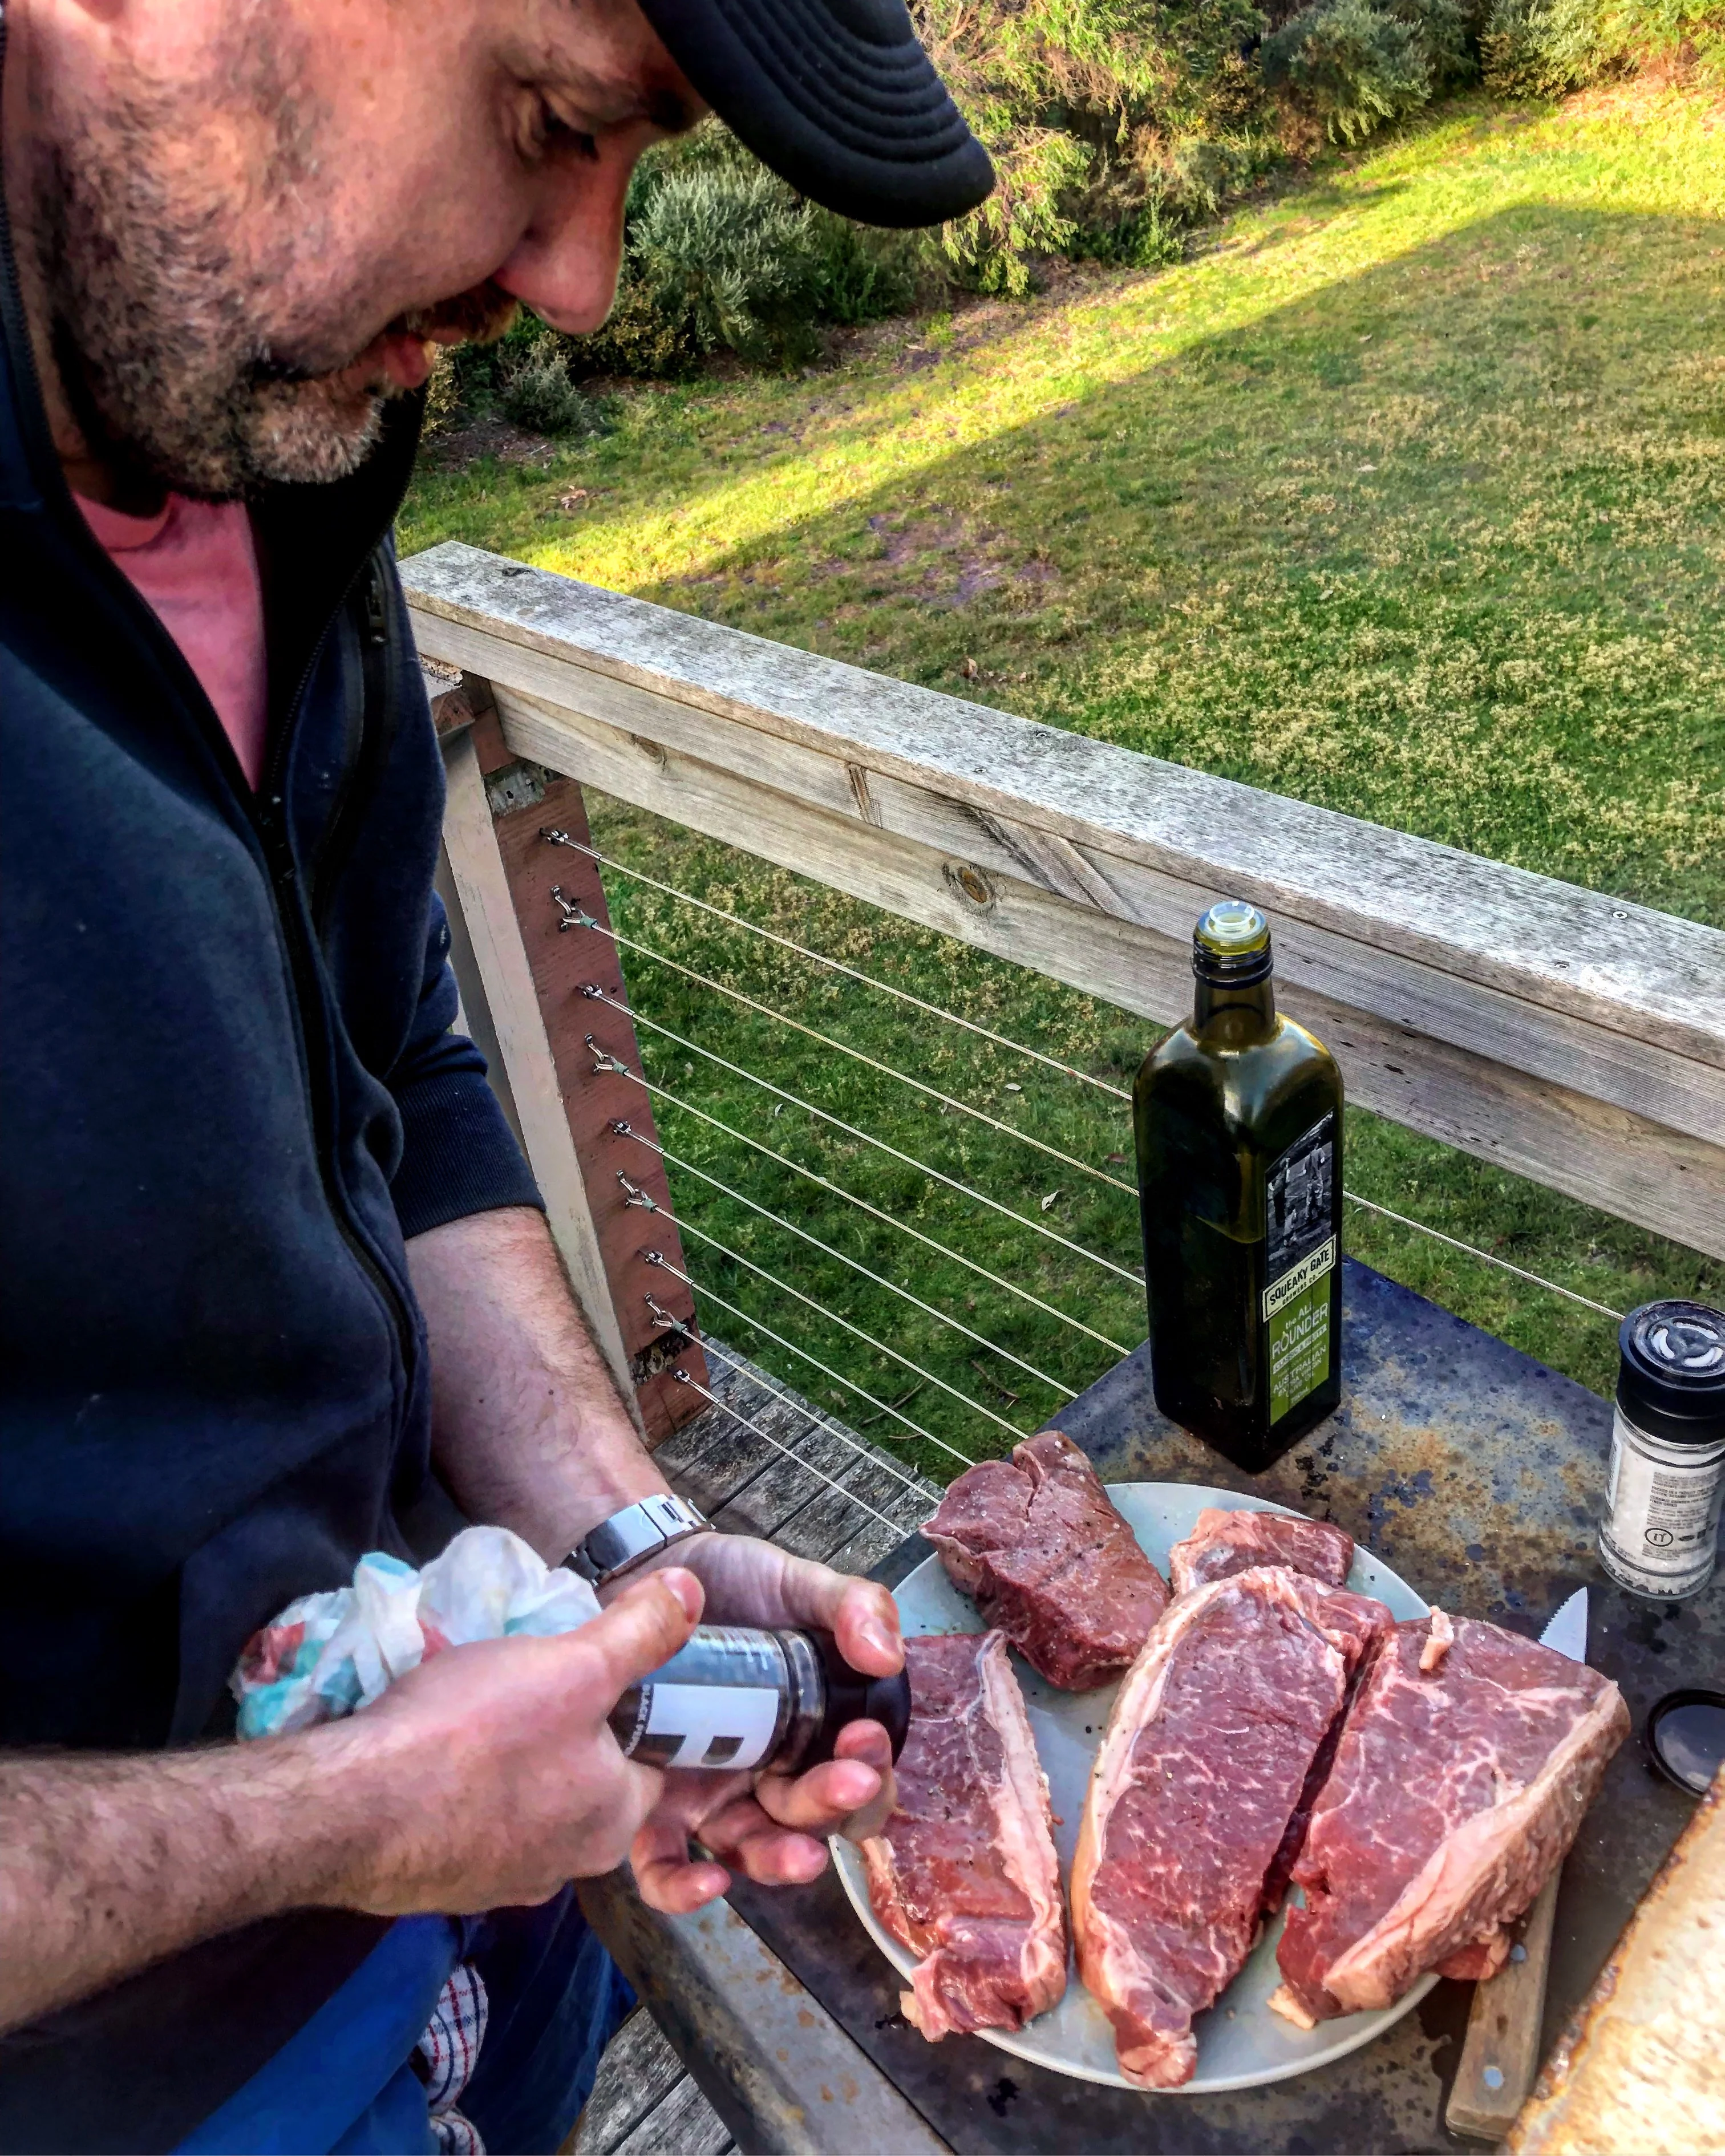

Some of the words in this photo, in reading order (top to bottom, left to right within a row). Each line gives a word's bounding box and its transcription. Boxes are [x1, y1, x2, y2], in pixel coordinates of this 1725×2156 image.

[1270, 1266, 1308, 1306] SQUEAKY
[1310, 1249, 1330, 1271] GATE
[1282, 1282, 1307, 1306] GROWERS
[1309, 1274, 1318, 1283] CO.
[1272, 1303, 1328, 1359] ROUNDER
[1286, 1318, 1297, 1329] the
[1298, 1302, 1314, 1320] ALL
[1273, 1345, 1326, 1394] AUSTRALIAN
